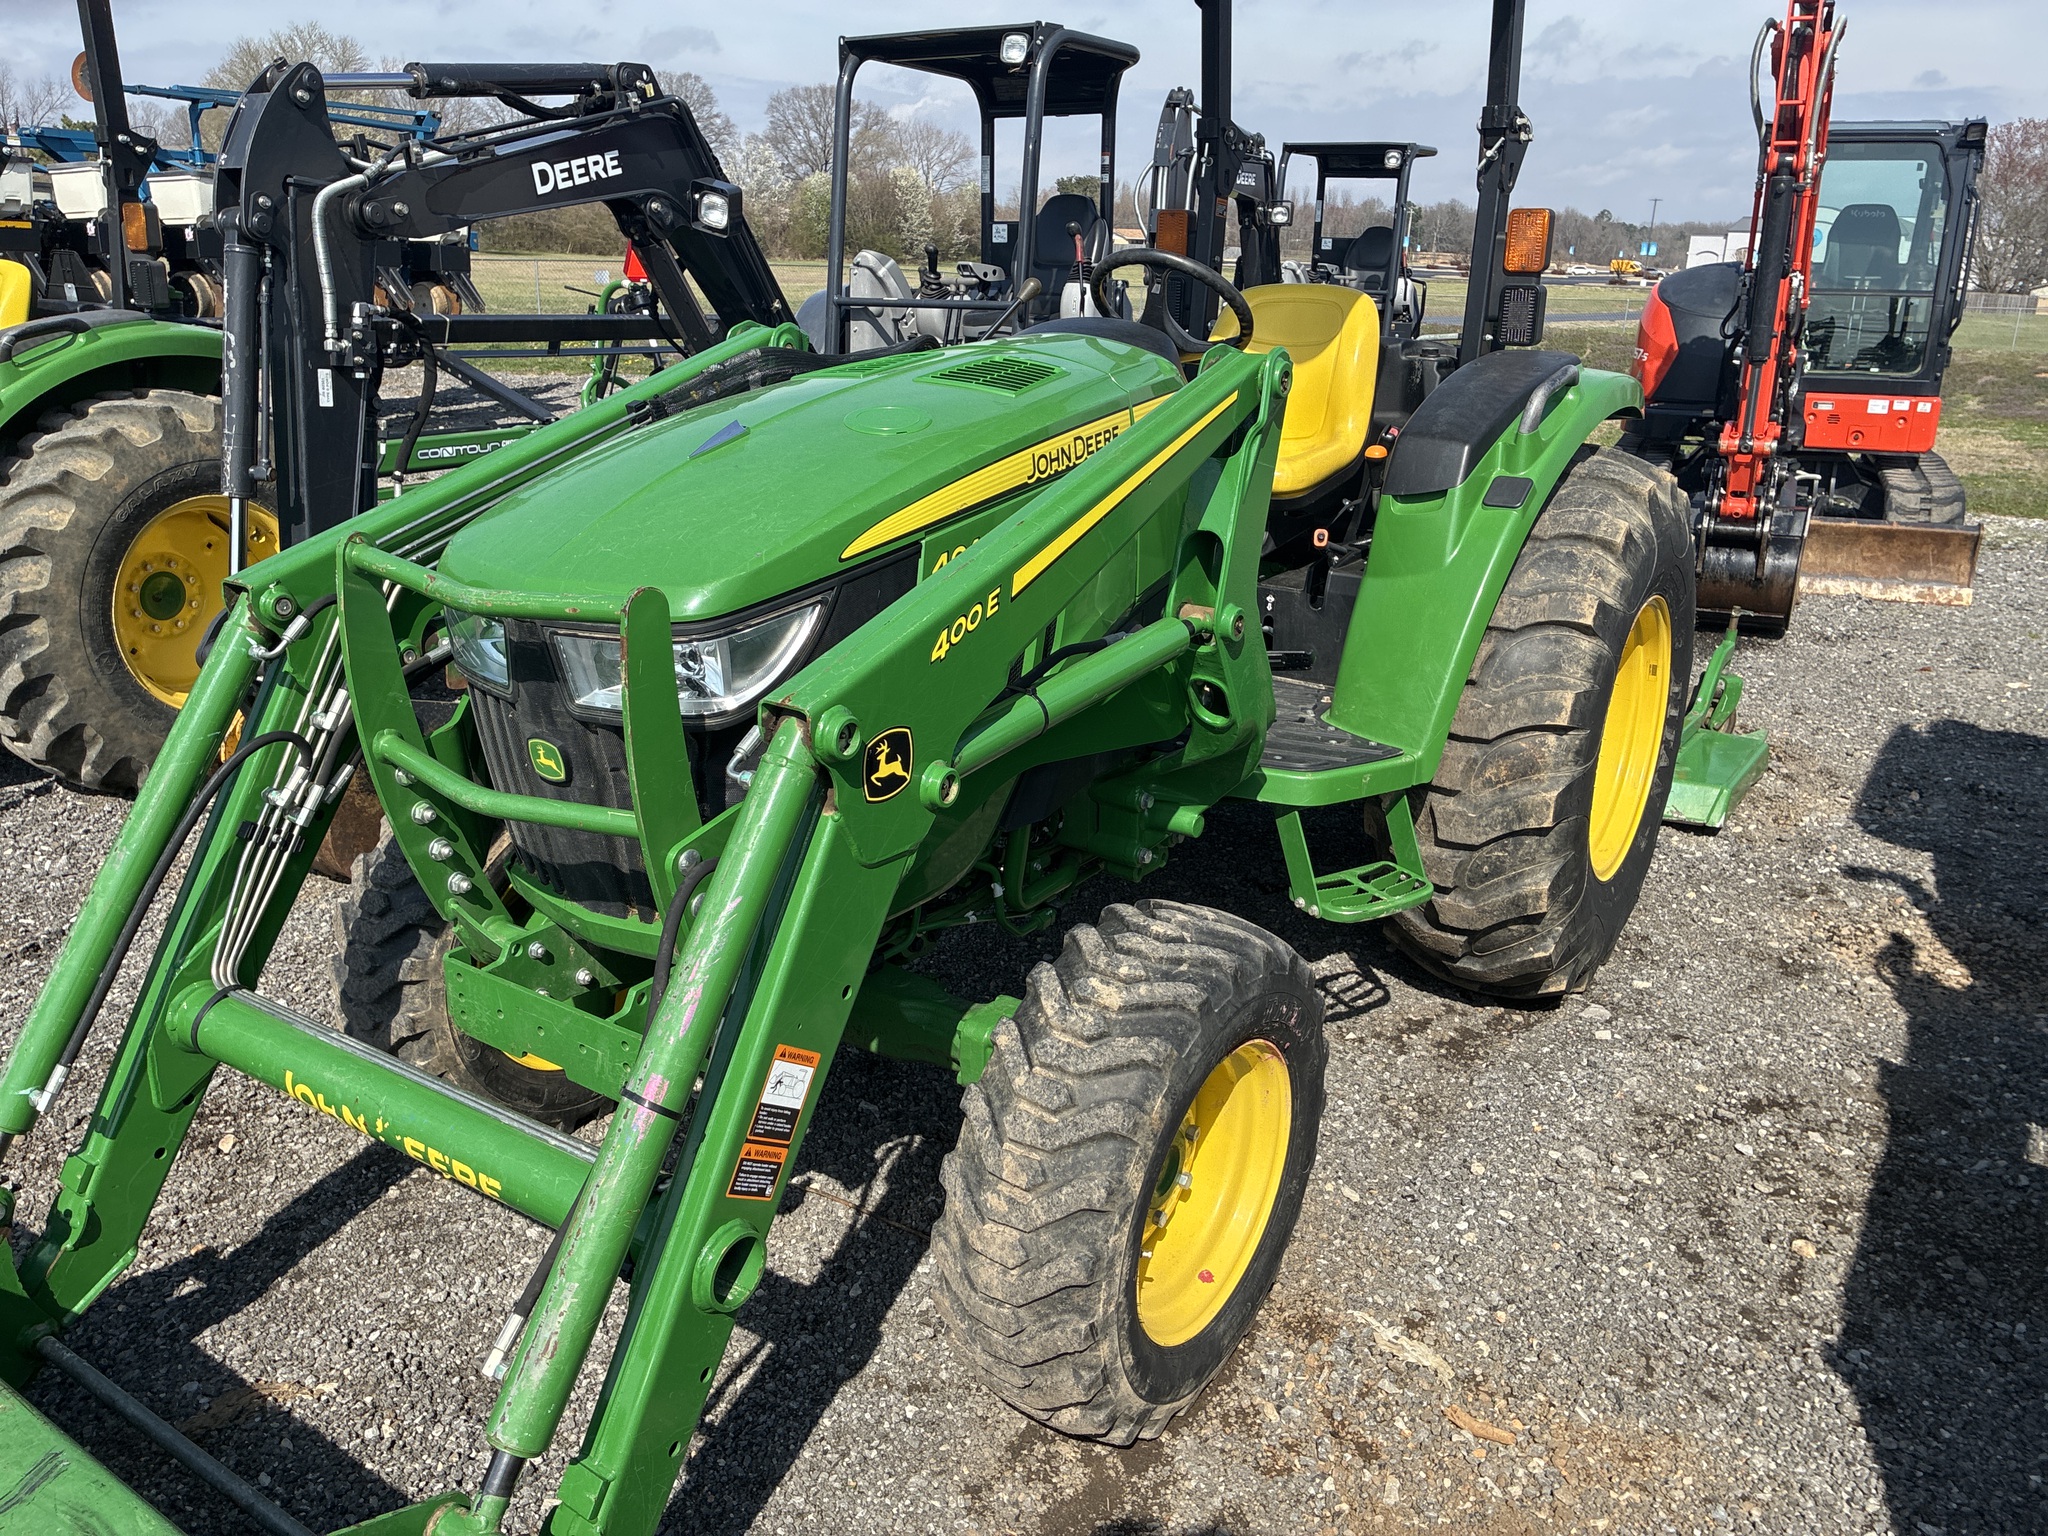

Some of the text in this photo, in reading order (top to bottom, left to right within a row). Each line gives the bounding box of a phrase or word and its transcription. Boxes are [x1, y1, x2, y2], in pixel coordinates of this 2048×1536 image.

[530, 149, 623, 196] DEERE
[1851, 209, 1886, 218] Kubota
[1026, 443, 1073, 481] JOHN
[787, 1050, 815, 1064] WARNING
[754, 1149, 783, 1160] WARNING
